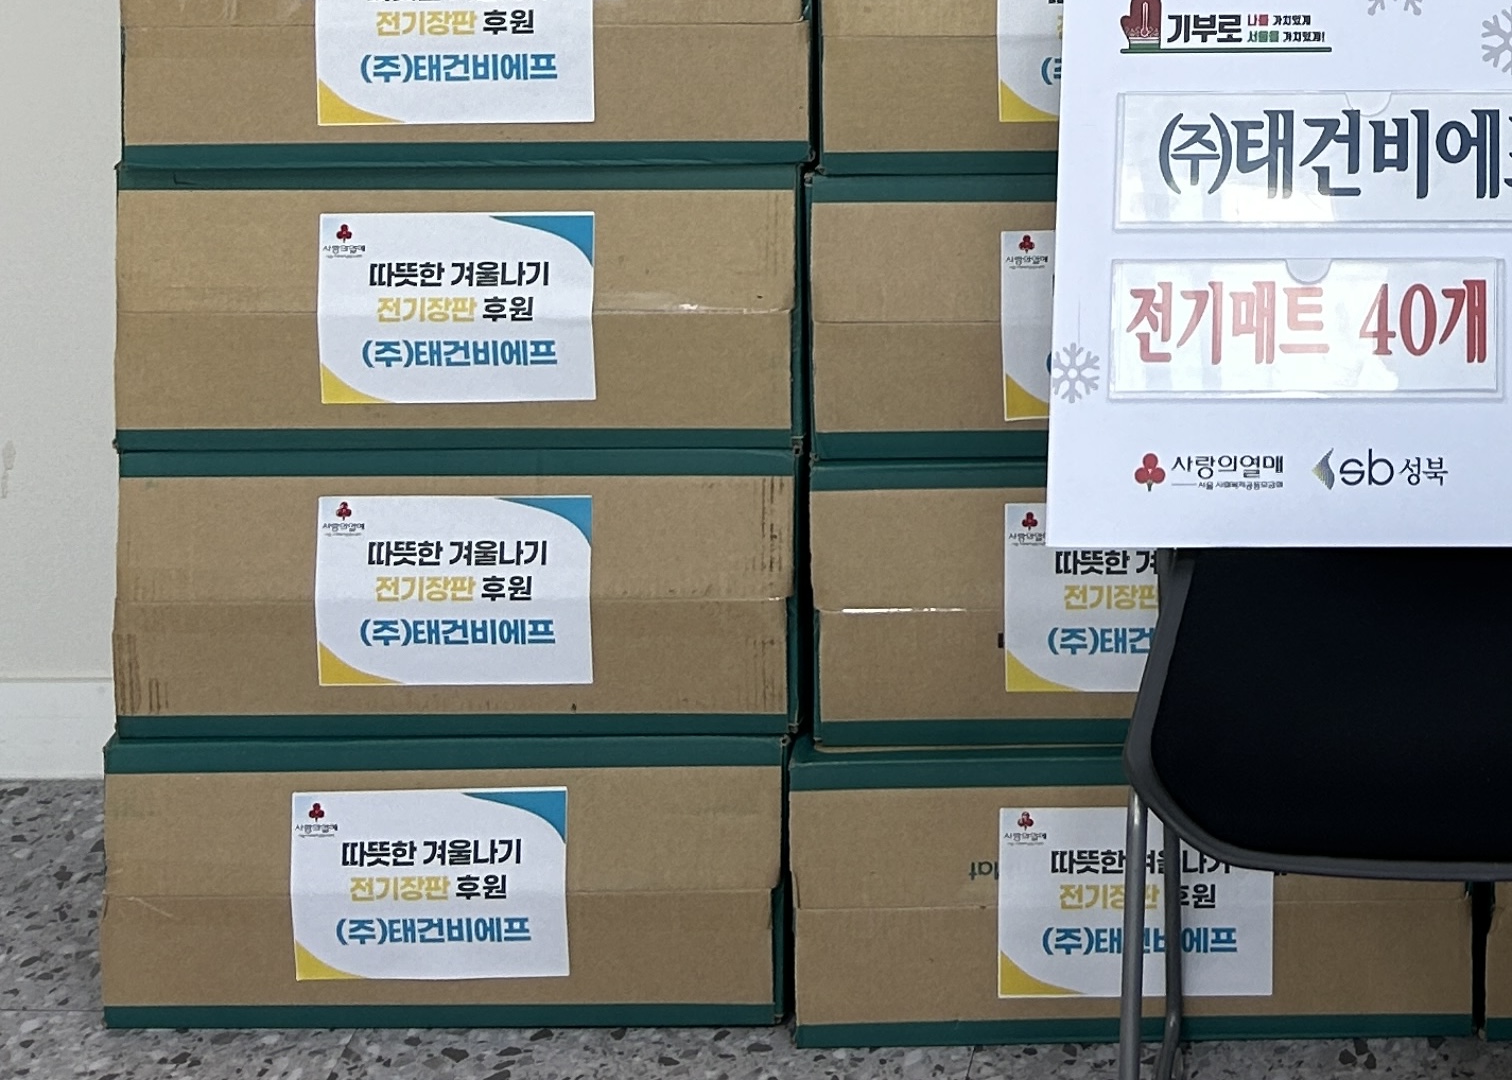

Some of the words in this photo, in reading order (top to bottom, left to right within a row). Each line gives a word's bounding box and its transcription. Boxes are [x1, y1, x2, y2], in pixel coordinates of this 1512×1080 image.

[376, 11, 477, 36] 전기장판
[482, 9, 535, 36] 후원
[1166, 14, 1243, 43] 기부로
[360, 52, 560, 83] (주)태건비에프
[369, 261, 445, 288] 따뜻한
[450, 261, 549, 287] 겨울나기
[377, 297, 477, 322] 전기장판
[482, 296, 534, 323] 후원
[1126, 280, 1330, 365] 전기매트
[1358, 279, 1487, 363] 40개
[361, 338, 558, 368] (주)태건비에프
[1171, 454, 1284, 480] 사랑의열매
[1339, 448, 1395, 487] sb
[1399, 456, 1449, 487] 성북
[367, 540, 444, 567] 따뜻한
[449, 540, 547, 566] 겨울나기
[1055, 550, 1131, 575] 따뜻한
[375, 577, 476, 601] 전기장판
[481, 575, 532, 602] 후원
[359, 618, 556, 646] (주)태건비에프
[1047, 626, 1157, 655] (주)태건
[341, 840, 418, 868] 따뜻한
[422, 838, 522, 866] 겨울나기
[1050, 849, 1126, 875] 따뜻한
[350, 877, 450, 900] 전기장판
[455, 874, 507, 901] 후원
[335, 916, 530, 945] (주)태건비에프
